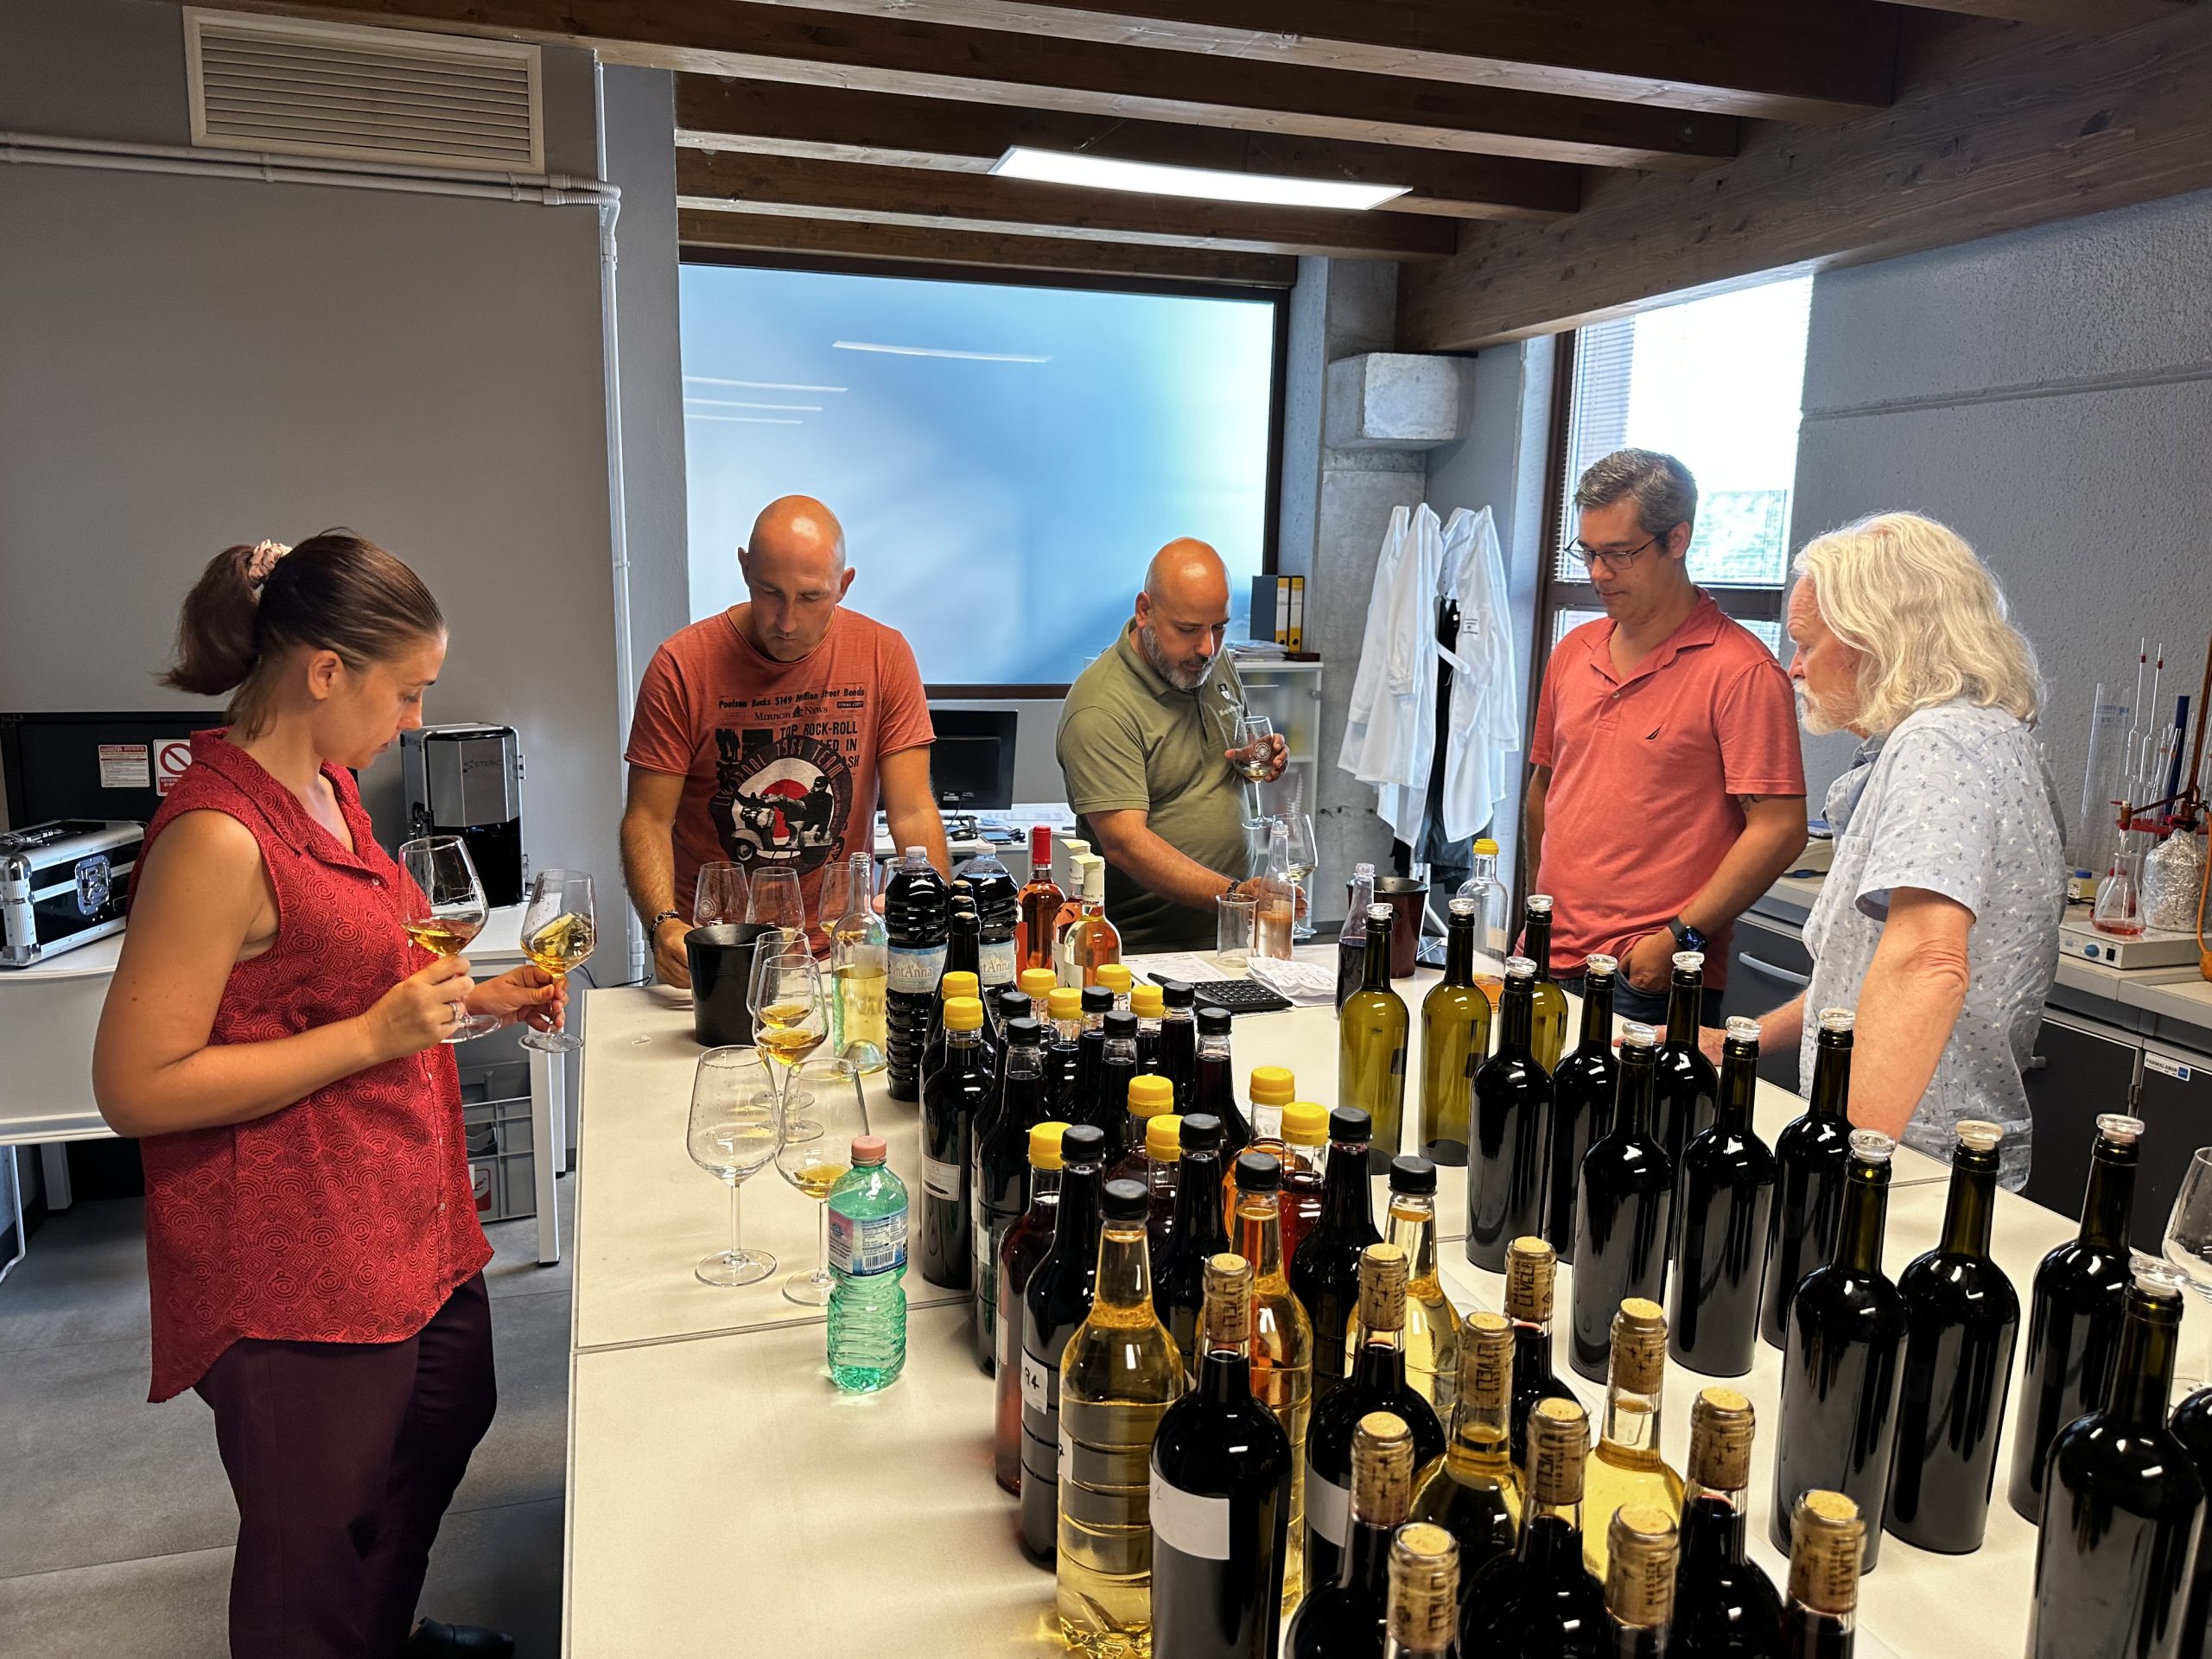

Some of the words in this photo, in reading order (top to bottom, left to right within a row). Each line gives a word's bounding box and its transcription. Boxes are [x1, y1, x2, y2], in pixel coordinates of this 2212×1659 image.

[796, 691, 818, 702] Million
[821, 688, 840, 699] Street
[843, 686, 865, 696] Bonds
[780, 724, 798, 739] TOP
[803, 721, 858, 736] ROCK-ROLL
[846, 739, 857, 752] IN
[776, 738, 804, 756] 1964
[810, 744, 844, 779] TEAM
